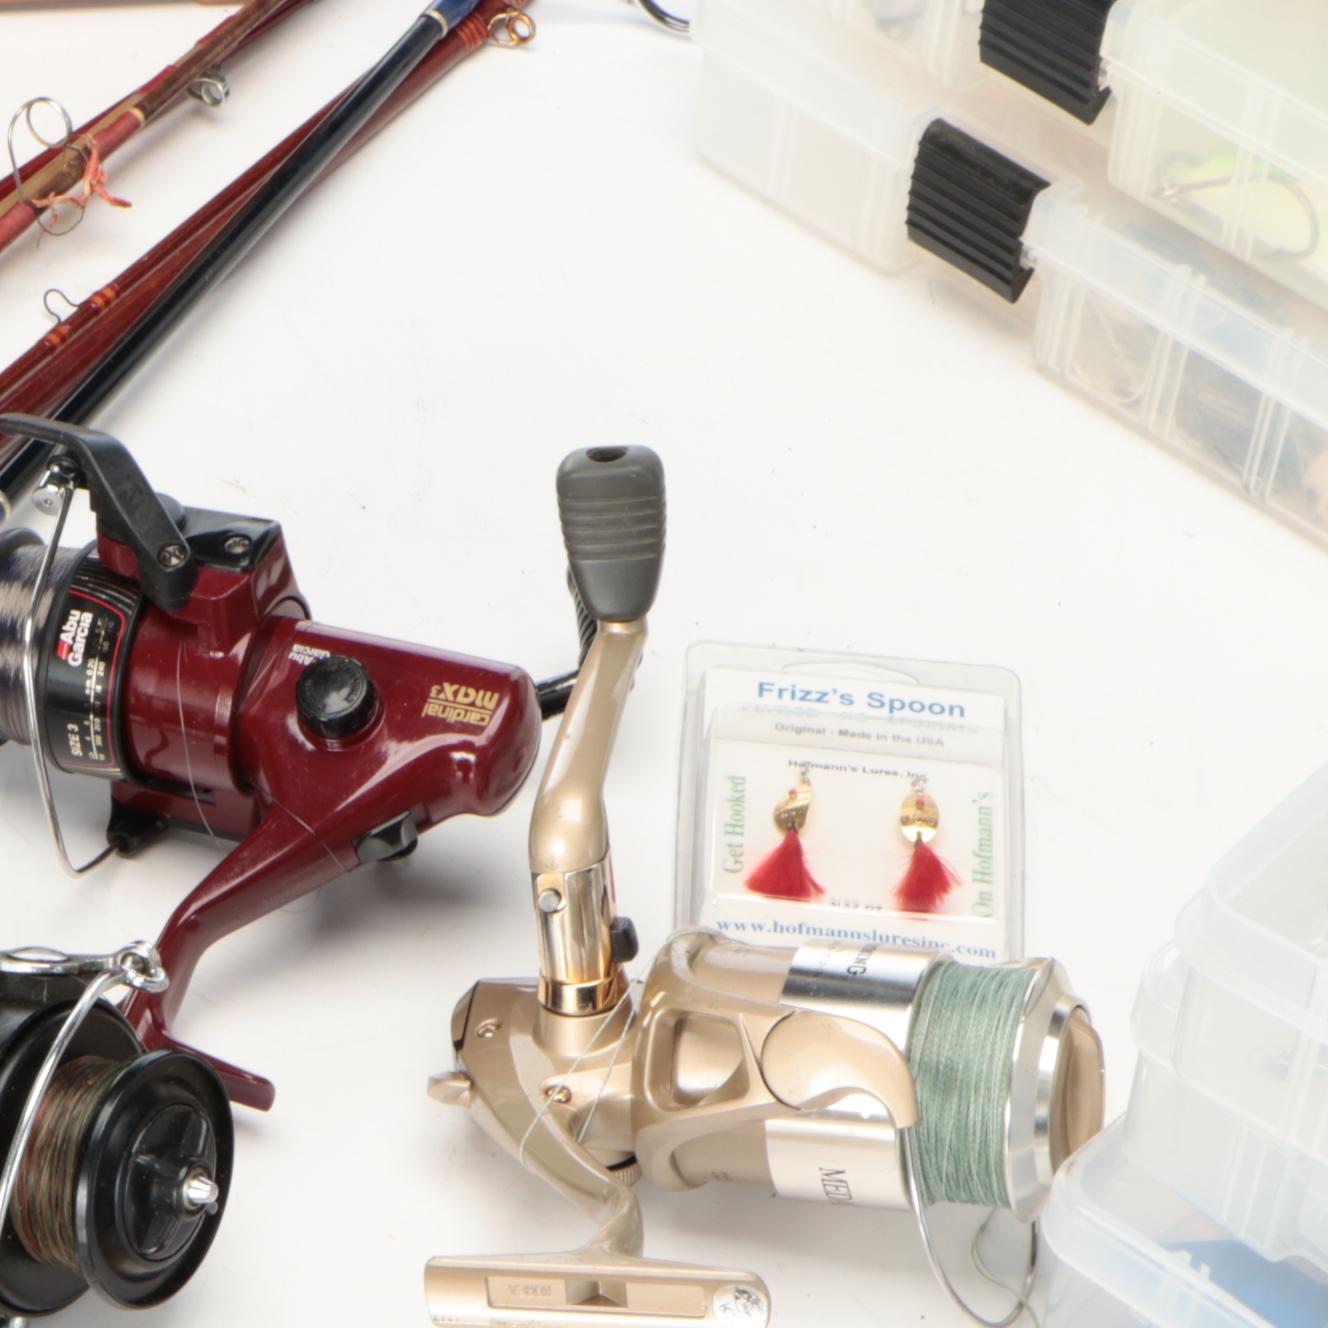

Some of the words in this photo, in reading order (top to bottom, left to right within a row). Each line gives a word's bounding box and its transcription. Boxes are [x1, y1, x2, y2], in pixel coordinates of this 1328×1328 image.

[60, 609, 81, 645] Abu
[67, 612, 93, 667] Garcia
[288, 651, 314, 667] Abu
[422, 702, 493, 727] cardinal
[758, 681, 855, 706] Frizz's
[866, 691, 966, 718] Spoon
[67, 723, 80, 732] 3
[775, 723, 827, 736] Original
[838, 729, 872, 740] Made
[876, 731, 888, 741] in
[892, 733, 912, 743] the
[916, 736, 945, 746] USA
[68, 733, 83, 757] SIZE
[722, 775, 747, 836] Hooked
[971, 791, 993, 886] Hofmann's
[721, 842, 744, 874] Get
[971, 890, 993, 918] On
